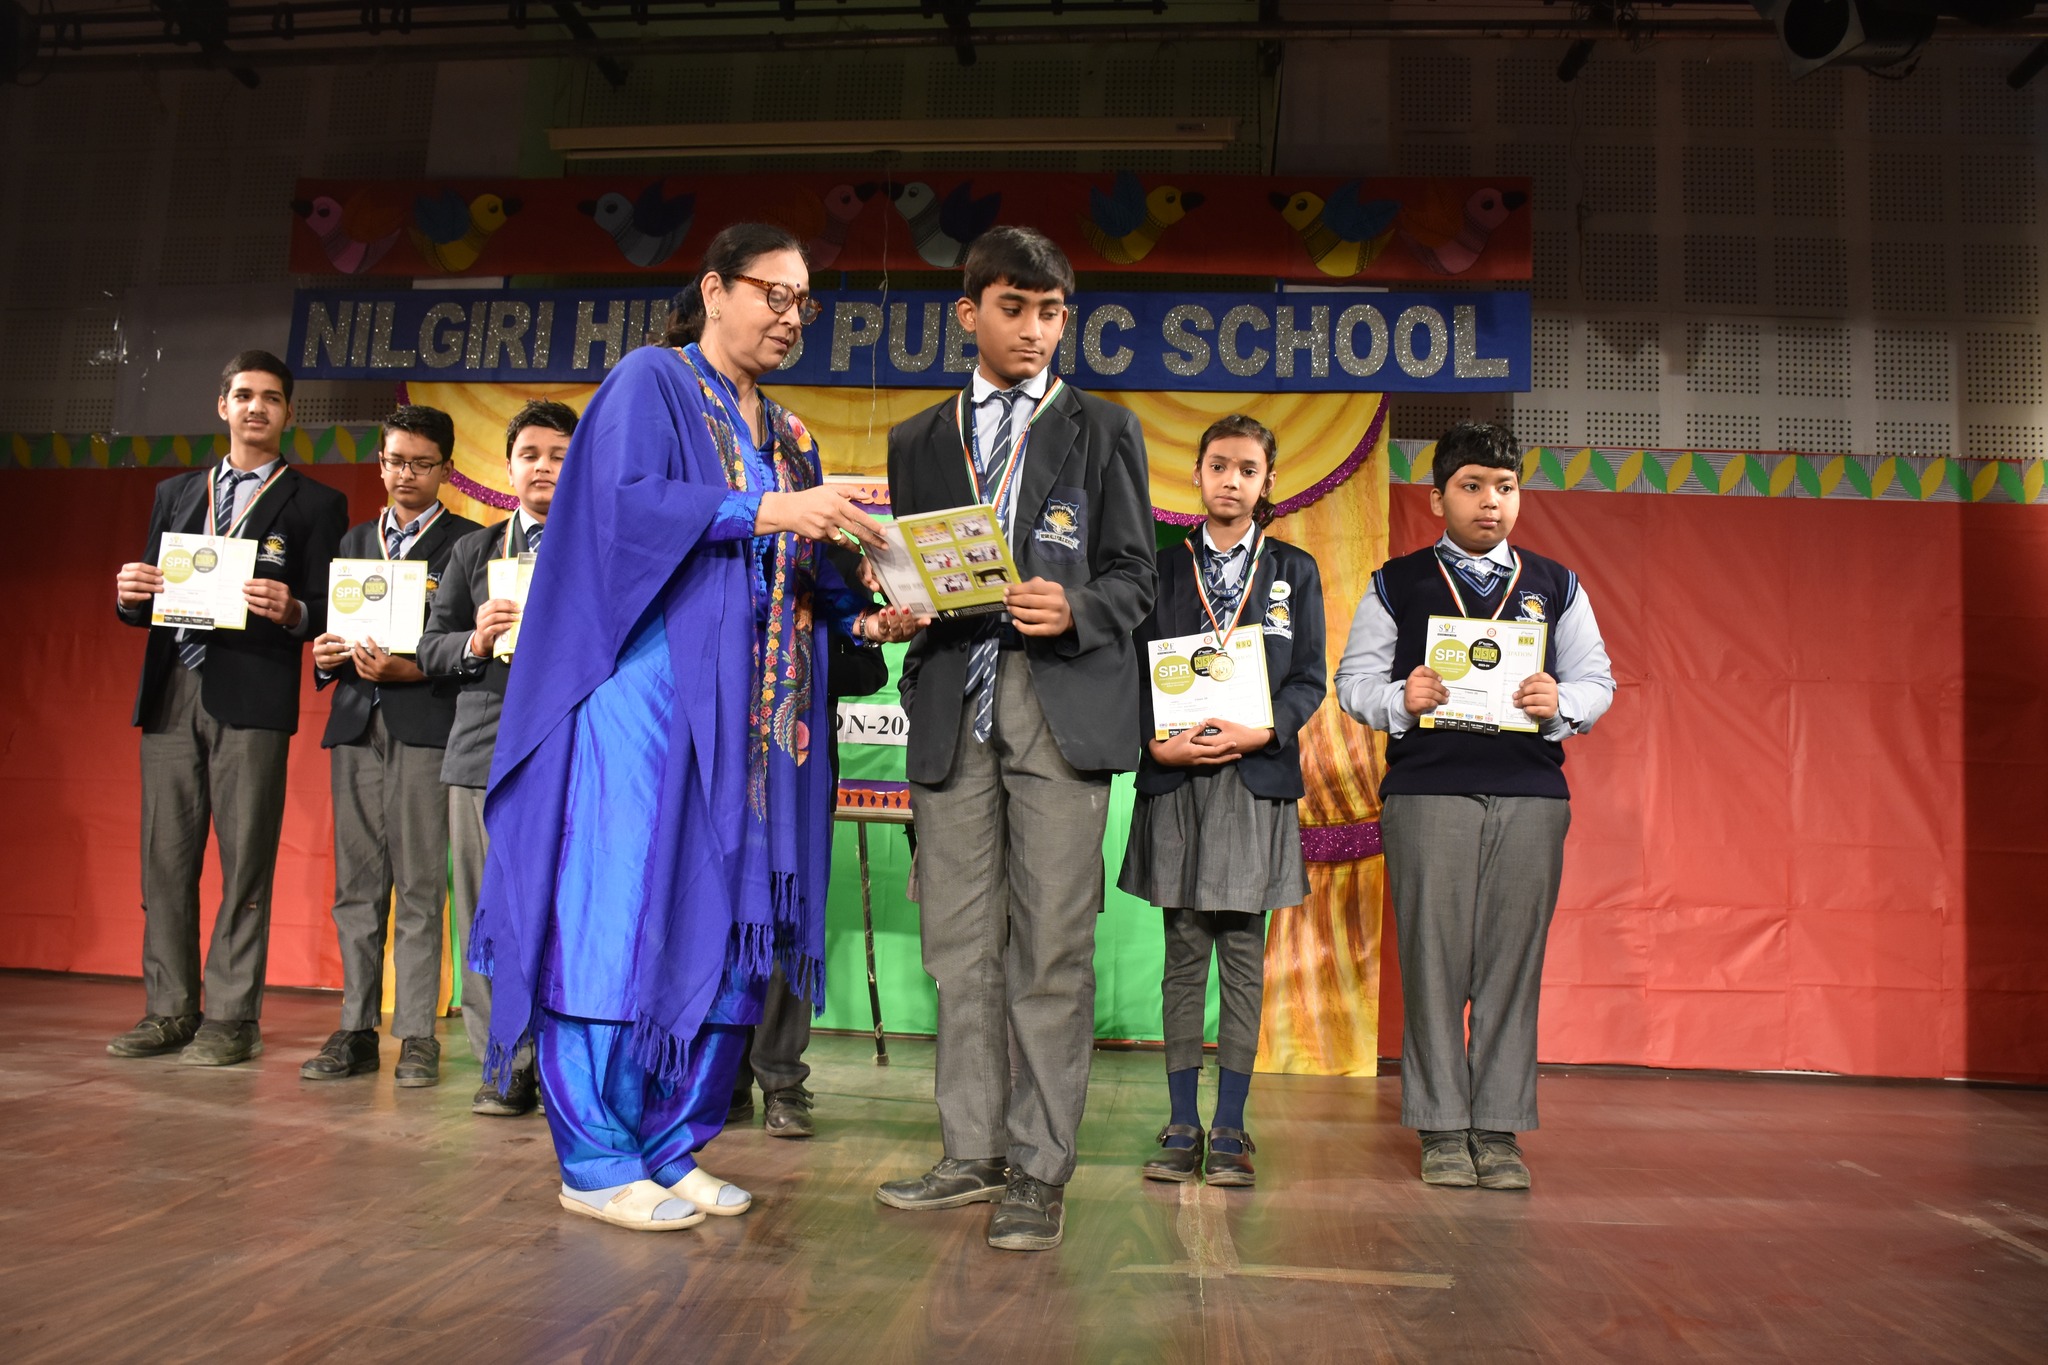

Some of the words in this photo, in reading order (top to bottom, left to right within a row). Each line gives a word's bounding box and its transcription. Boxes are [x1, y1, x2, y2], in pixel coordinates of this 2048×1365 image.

[301, 300, 554, 370] NILGIRI
[829, 302, 1136, 376] PUBIC
[1162, 304, 1510, 378] SCHOOL
[166, 556, 191, 568] SPR
[335, 586, 361, 598] SPR
[1435, 648, 1467, 664] SPR
[1158, 663, 1190, 678] SPR
[836, 714, 911, 736] N-20
